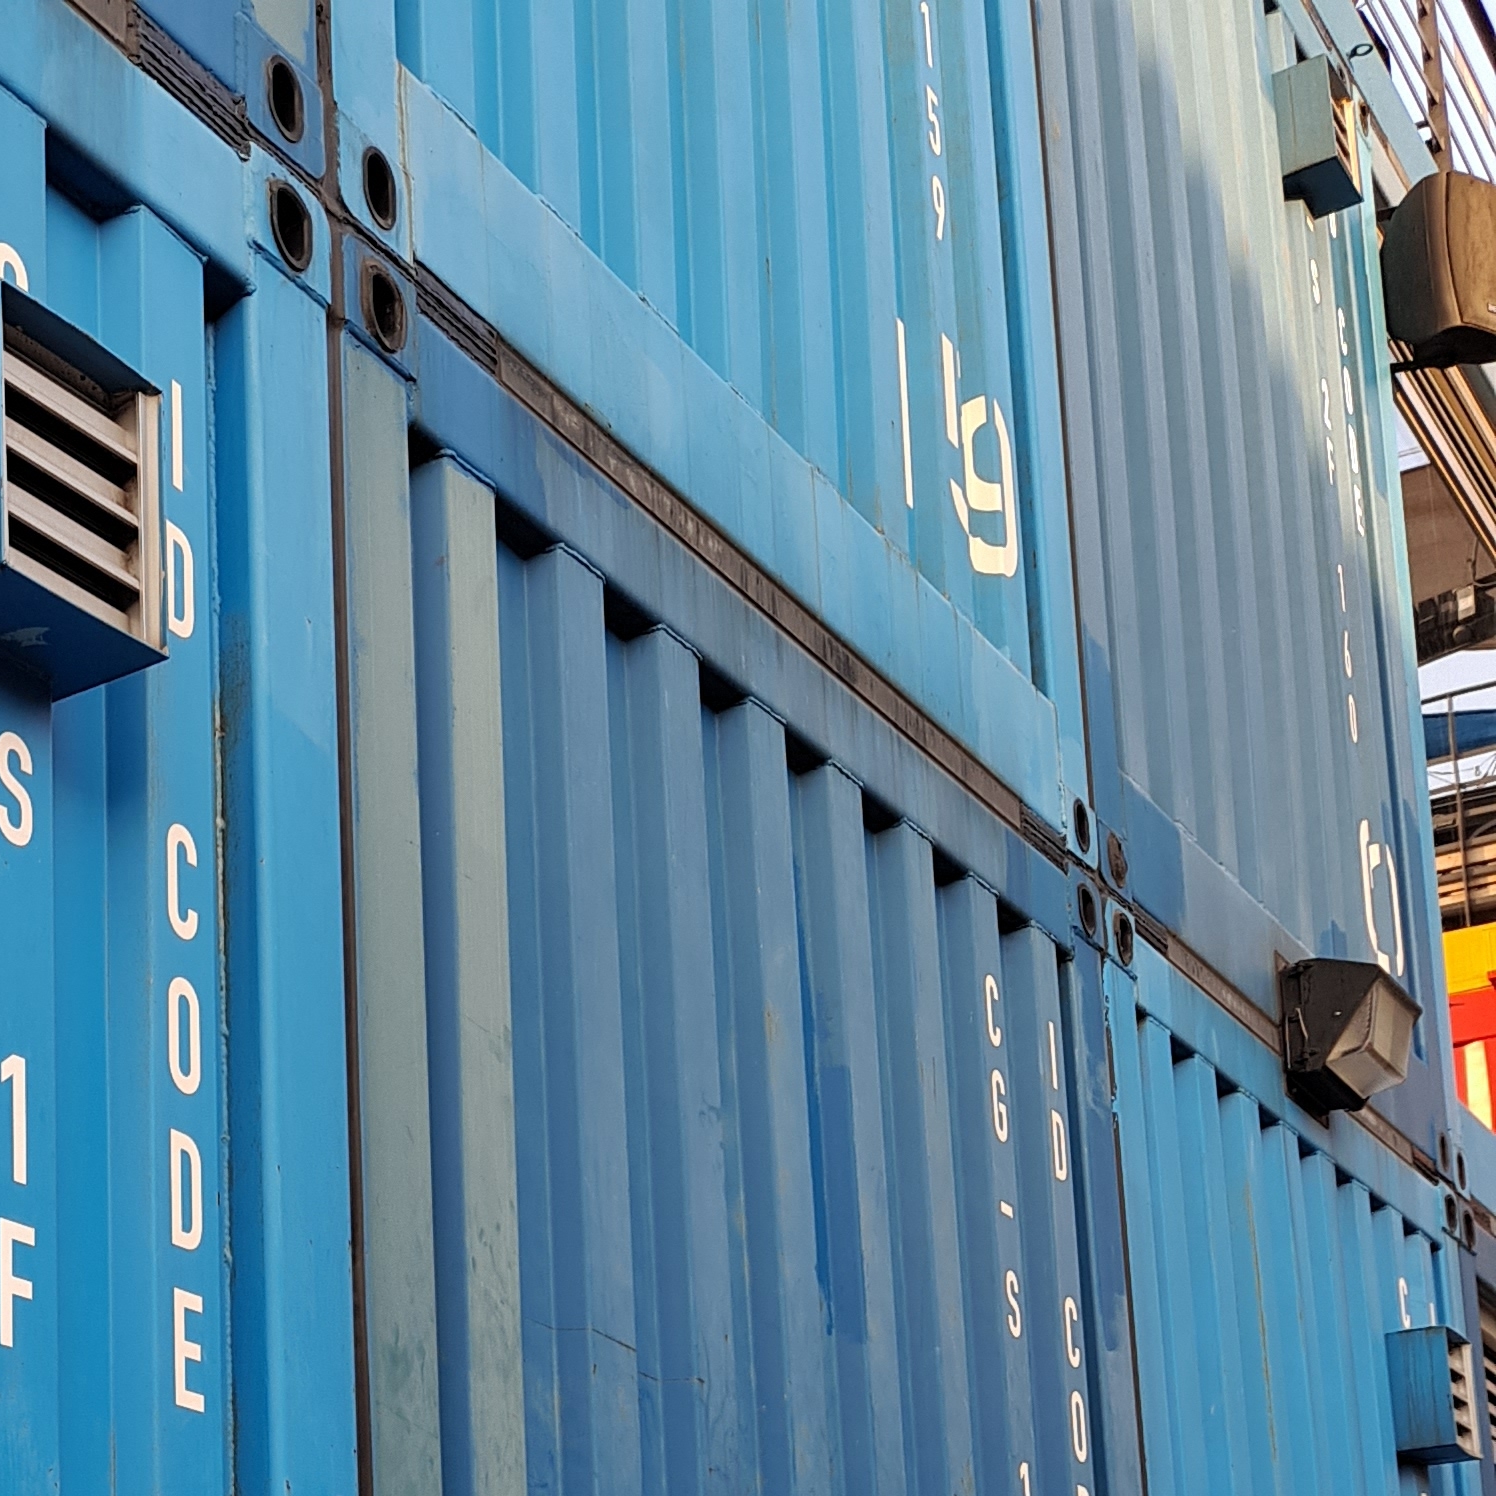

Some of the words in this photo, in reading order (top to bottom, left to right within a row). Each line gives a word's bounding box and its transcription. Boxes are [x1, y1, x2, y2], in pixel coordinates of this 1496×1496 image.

[165, 379, 195, 639] ID
[1337, 564, 1358, 744] 160
[0, 1054, 36, 1348] 1F
[166, 823, 205, 1413] CODE
[1048, 1021, 1068, 1181] ID
